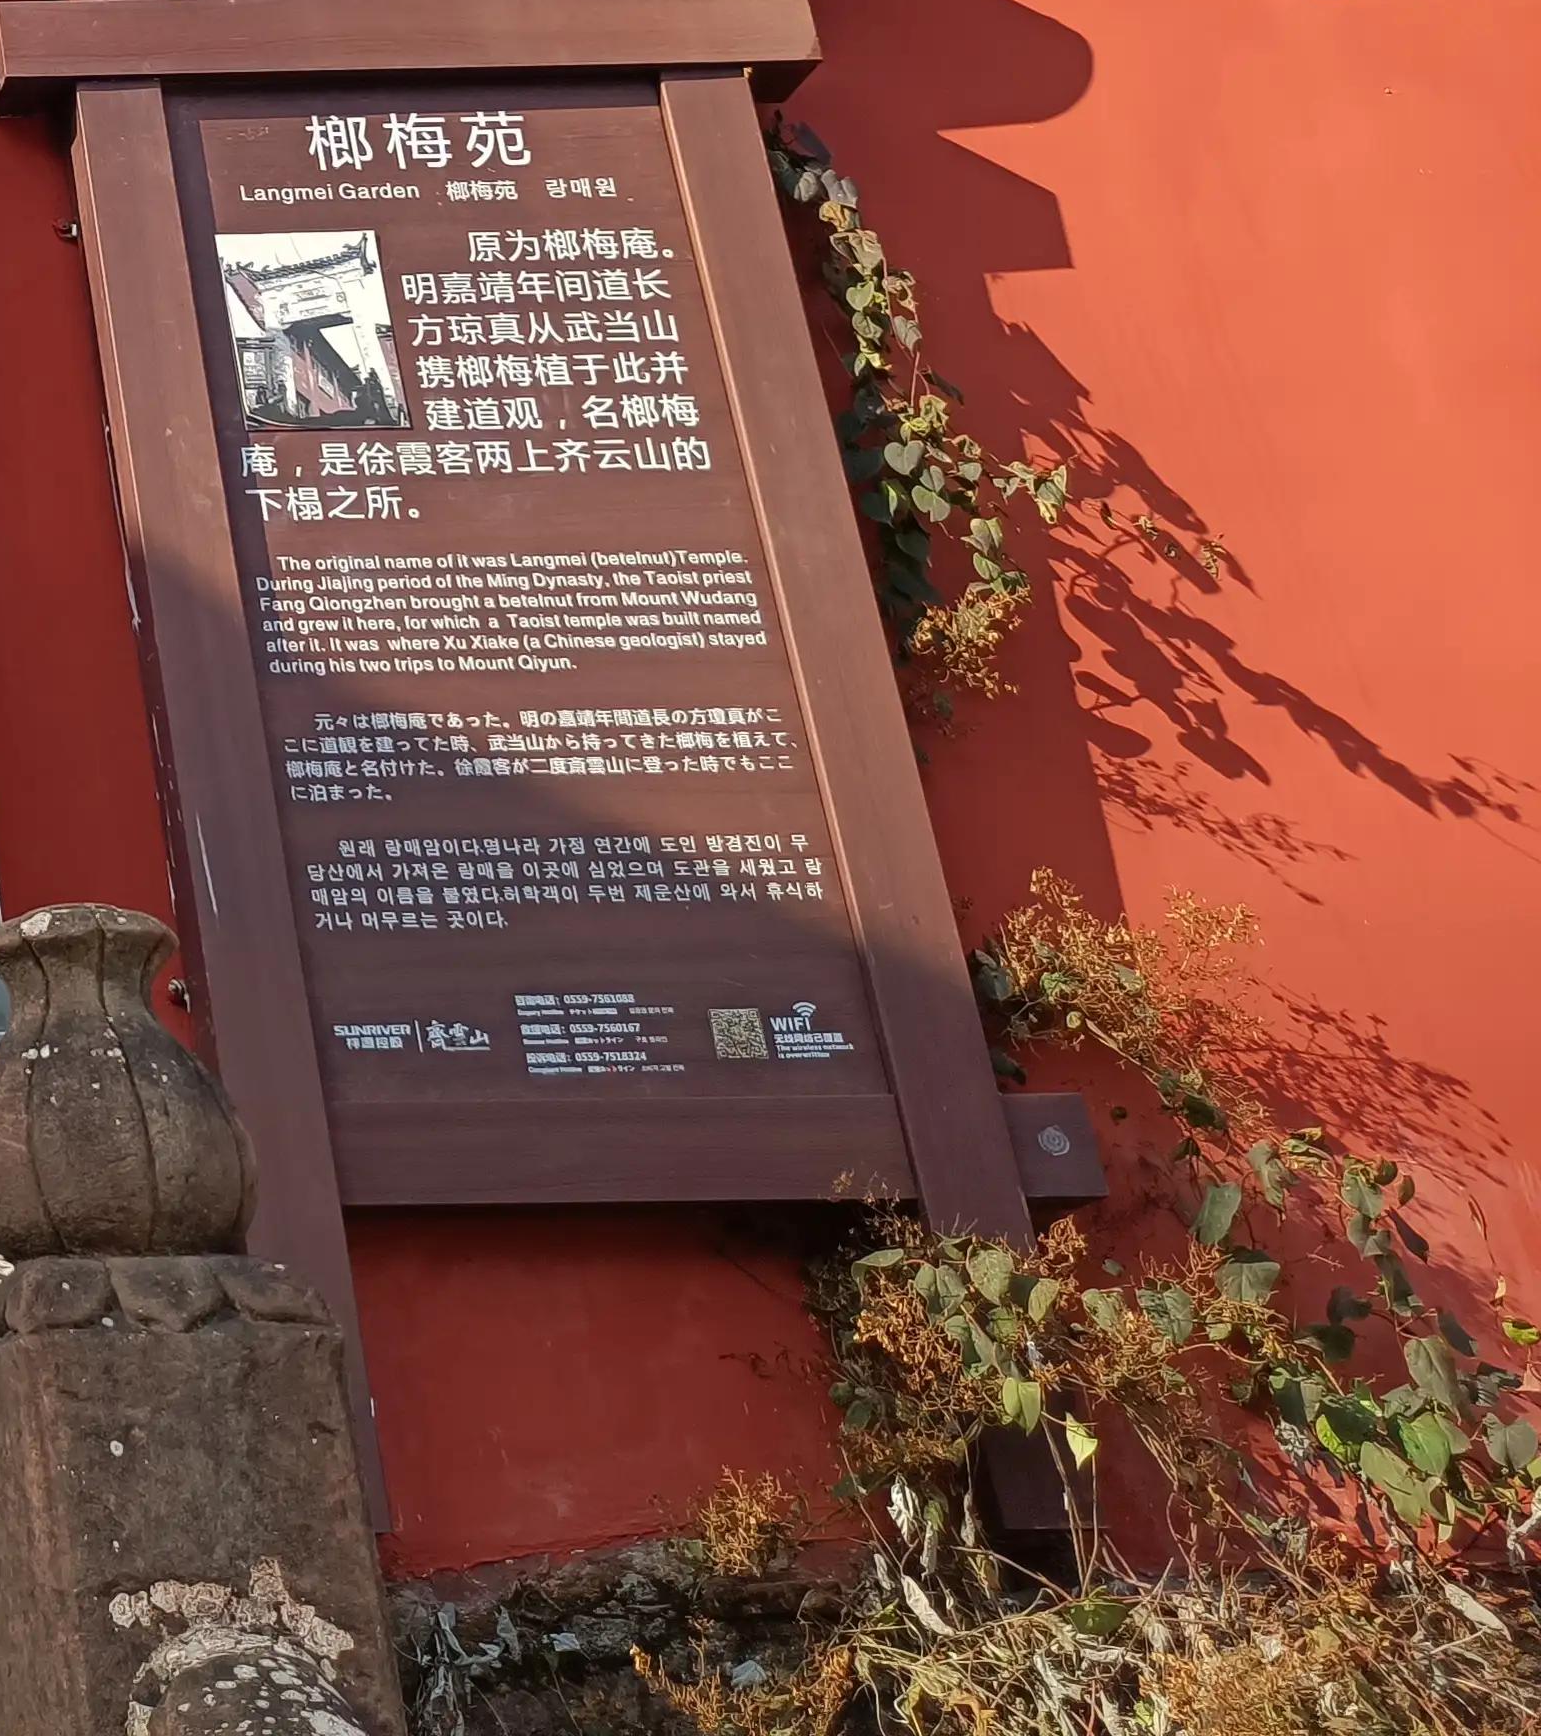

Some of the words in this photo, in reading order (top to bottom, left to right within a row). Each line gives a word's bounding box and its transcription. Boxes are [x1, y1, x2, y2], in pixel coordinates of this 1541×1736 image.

[305, 111, 532, 171] 榔梅苑
[239, 183, 333, 204] Langmei
[339, 183, 419, 200] Garden
[446, 180, 518, 201] 榔梅苑
[545, 177, 617, 198] 랑매원
[468, 228, 674, 263] 原为榔梅庵。
[400, 268, 671, 304] 明嘉靖年间道长
[408, 309, 678, 346] 方琼真从武当山
[416, 350, 688, 389] 携榔梅植于此并
[250, 486, 422, 523] 下榻之所。
[277, 556, 311, 571] The
[316, 555, 379, 573] original
[385, 556, 432, 569] name
[437, 554, 453, 568] of
[457, 554, 469, 568] it
[472, 556, 505, 567] was
[510, 553, 587, 570] Langmei
[256, 577, 313, 593] During
[318, 576, 373, 593] Jiajing
[378, 574, 432, 591] period
[436, 574, 452, 588] of
[456, 575, 482, 587] the
[487, 573, 529, 590] Ming
[613, 571, 641, 585] the
[644, 571, 699, 585] Taoist
[703, 570, 752, 587] priest
[260, 597, 305, 614] Fang
[309, 595, 406, 613] Qiongzhen
[410, 594, 479, 611] brought
[484, 597, 494, 608] a
[498, 593, 572, 608] betelnut
[577, 593, 618, 607] from
[621, 591, 677, 606] Mount
[681, 591, 757, 607] Wudang
[263, 618, 294, 632] and
[298, 618, 338, 634] grew
[342, 616, 353, 630] it
[357, 616, 402, 632] here,
[404, 615, 428, 630] for
[432, 615, 480, 630] which
[488, 618, 499, 629] a
[506, 614, 561, 628] Taoist
[565, 614, 621, 630] temple
[625, 615, 660, 626] was
[662, 612, 700, 626] built
[703, 611, 761, 625] named
[266, 638, 305, 652] after
[309, 638, 326, 652] it.
[330, 637, 341, 651] It
[346, 639, 379, 651] was
[388, 637, 440, 650] where
[443, 637, 467, 650] Xu
[471, 635, 518, 649] Xiake
[523, 635, 539, 652] (a
[544, 634, 616, 648] Chinese
[619, 632, 705, 650] geologist)
[709, 631, 767, 649] stayed
[269, 659, 325, 676] during
[329, 658, 355, 672] his
[359, 658, 391, 672] two
[394, 658, 434, 674] trips
[438, 658, 455, 671] to
[458, 656, 515, 671] Mount
[518, 655, 577, 672] Qiyun.
[291, 783, 393, 802] に泊まった。
[338, 839, 376, 858] 원래
[549, 836, 586, 856] 가정
[594, 836, 650, 854] 연간에
[661, 835, 696, 853] 도인
[706, 834, 781, 853] 방경진이
[790, 834, 808, 852] 무
[307, 863, 384, 882] 당산에서
[392, 863, 448, 880] 가져온
[524, 861, 580, 880] 이곳에
[588, 860, 665, 879] 심었으며
[674, 859, 730, 877] 도관을
[740, 858, 797, 877] 세웠고
[311, 887, 368, 906] 매암의
[377, 887, 434, 905] 이름을
[588, 886, 625, 903] 두번
[634, 883, 711, 902] 제운산에
[720, 883, 757, 901] 와서
[767, 882, 823, 901] 휴식하
[315, 914, 353, 931] 거나
[362, 912, 438, 930] 머무르는
[446, 910, 508, 929] 곳이다.
[334, 1024, 411, 1036] SUNRIVER
[569, 1023, 640, 1033] 0559-7560167
[770, 1017, 811, 1031] WIFI
